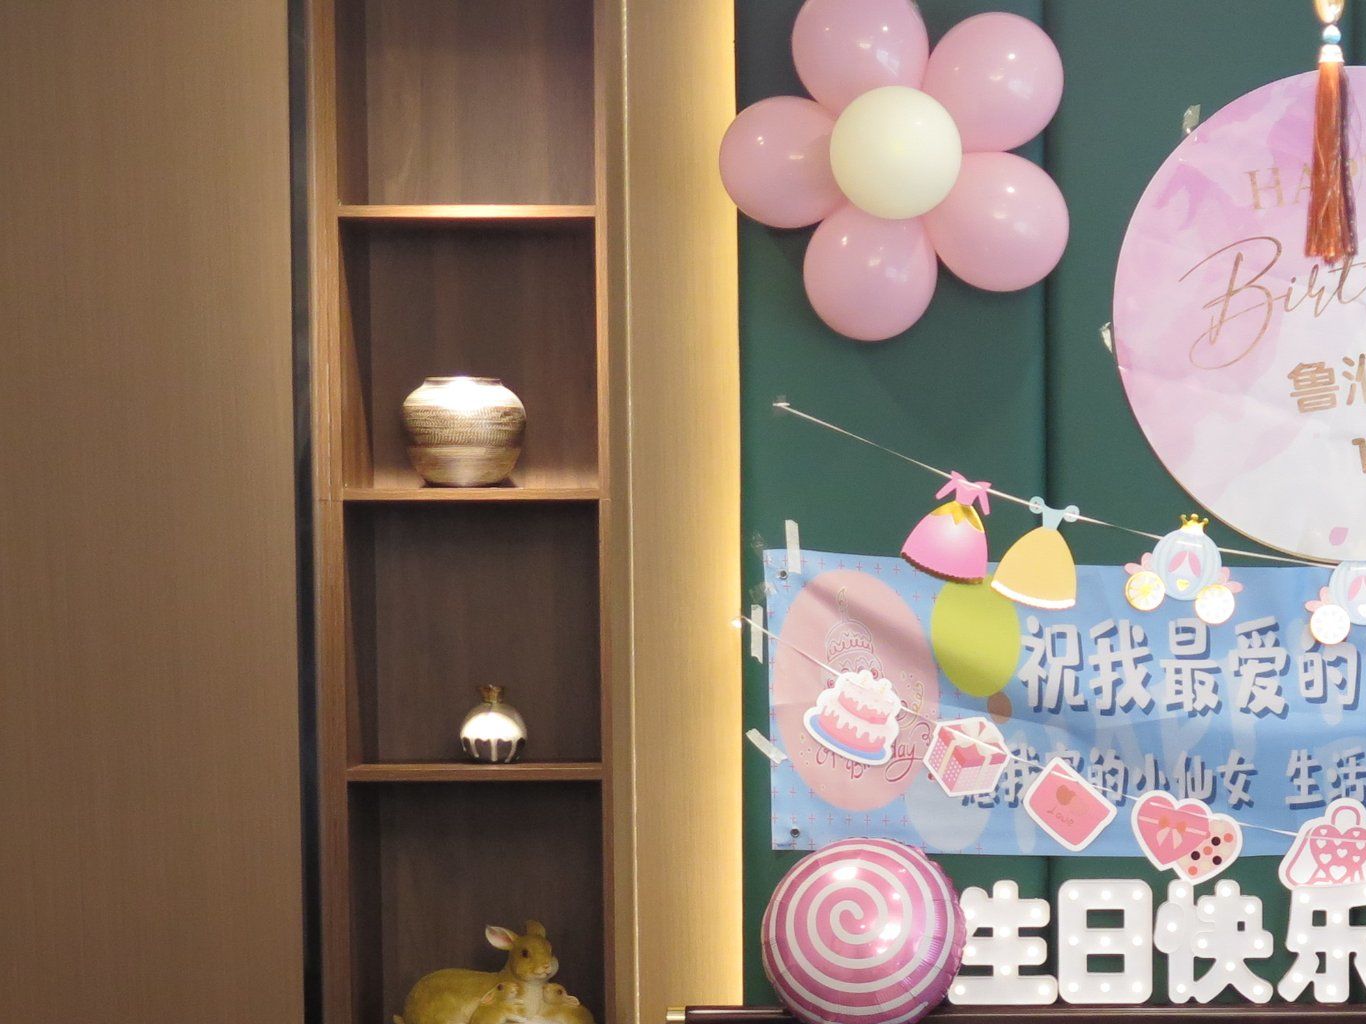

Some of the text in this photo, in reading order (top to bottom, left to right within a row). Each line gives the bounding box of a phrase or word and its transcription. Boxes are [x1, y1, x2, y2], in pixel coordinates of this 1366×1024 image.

[963, 743, 1257, 809] 我的小仙女
